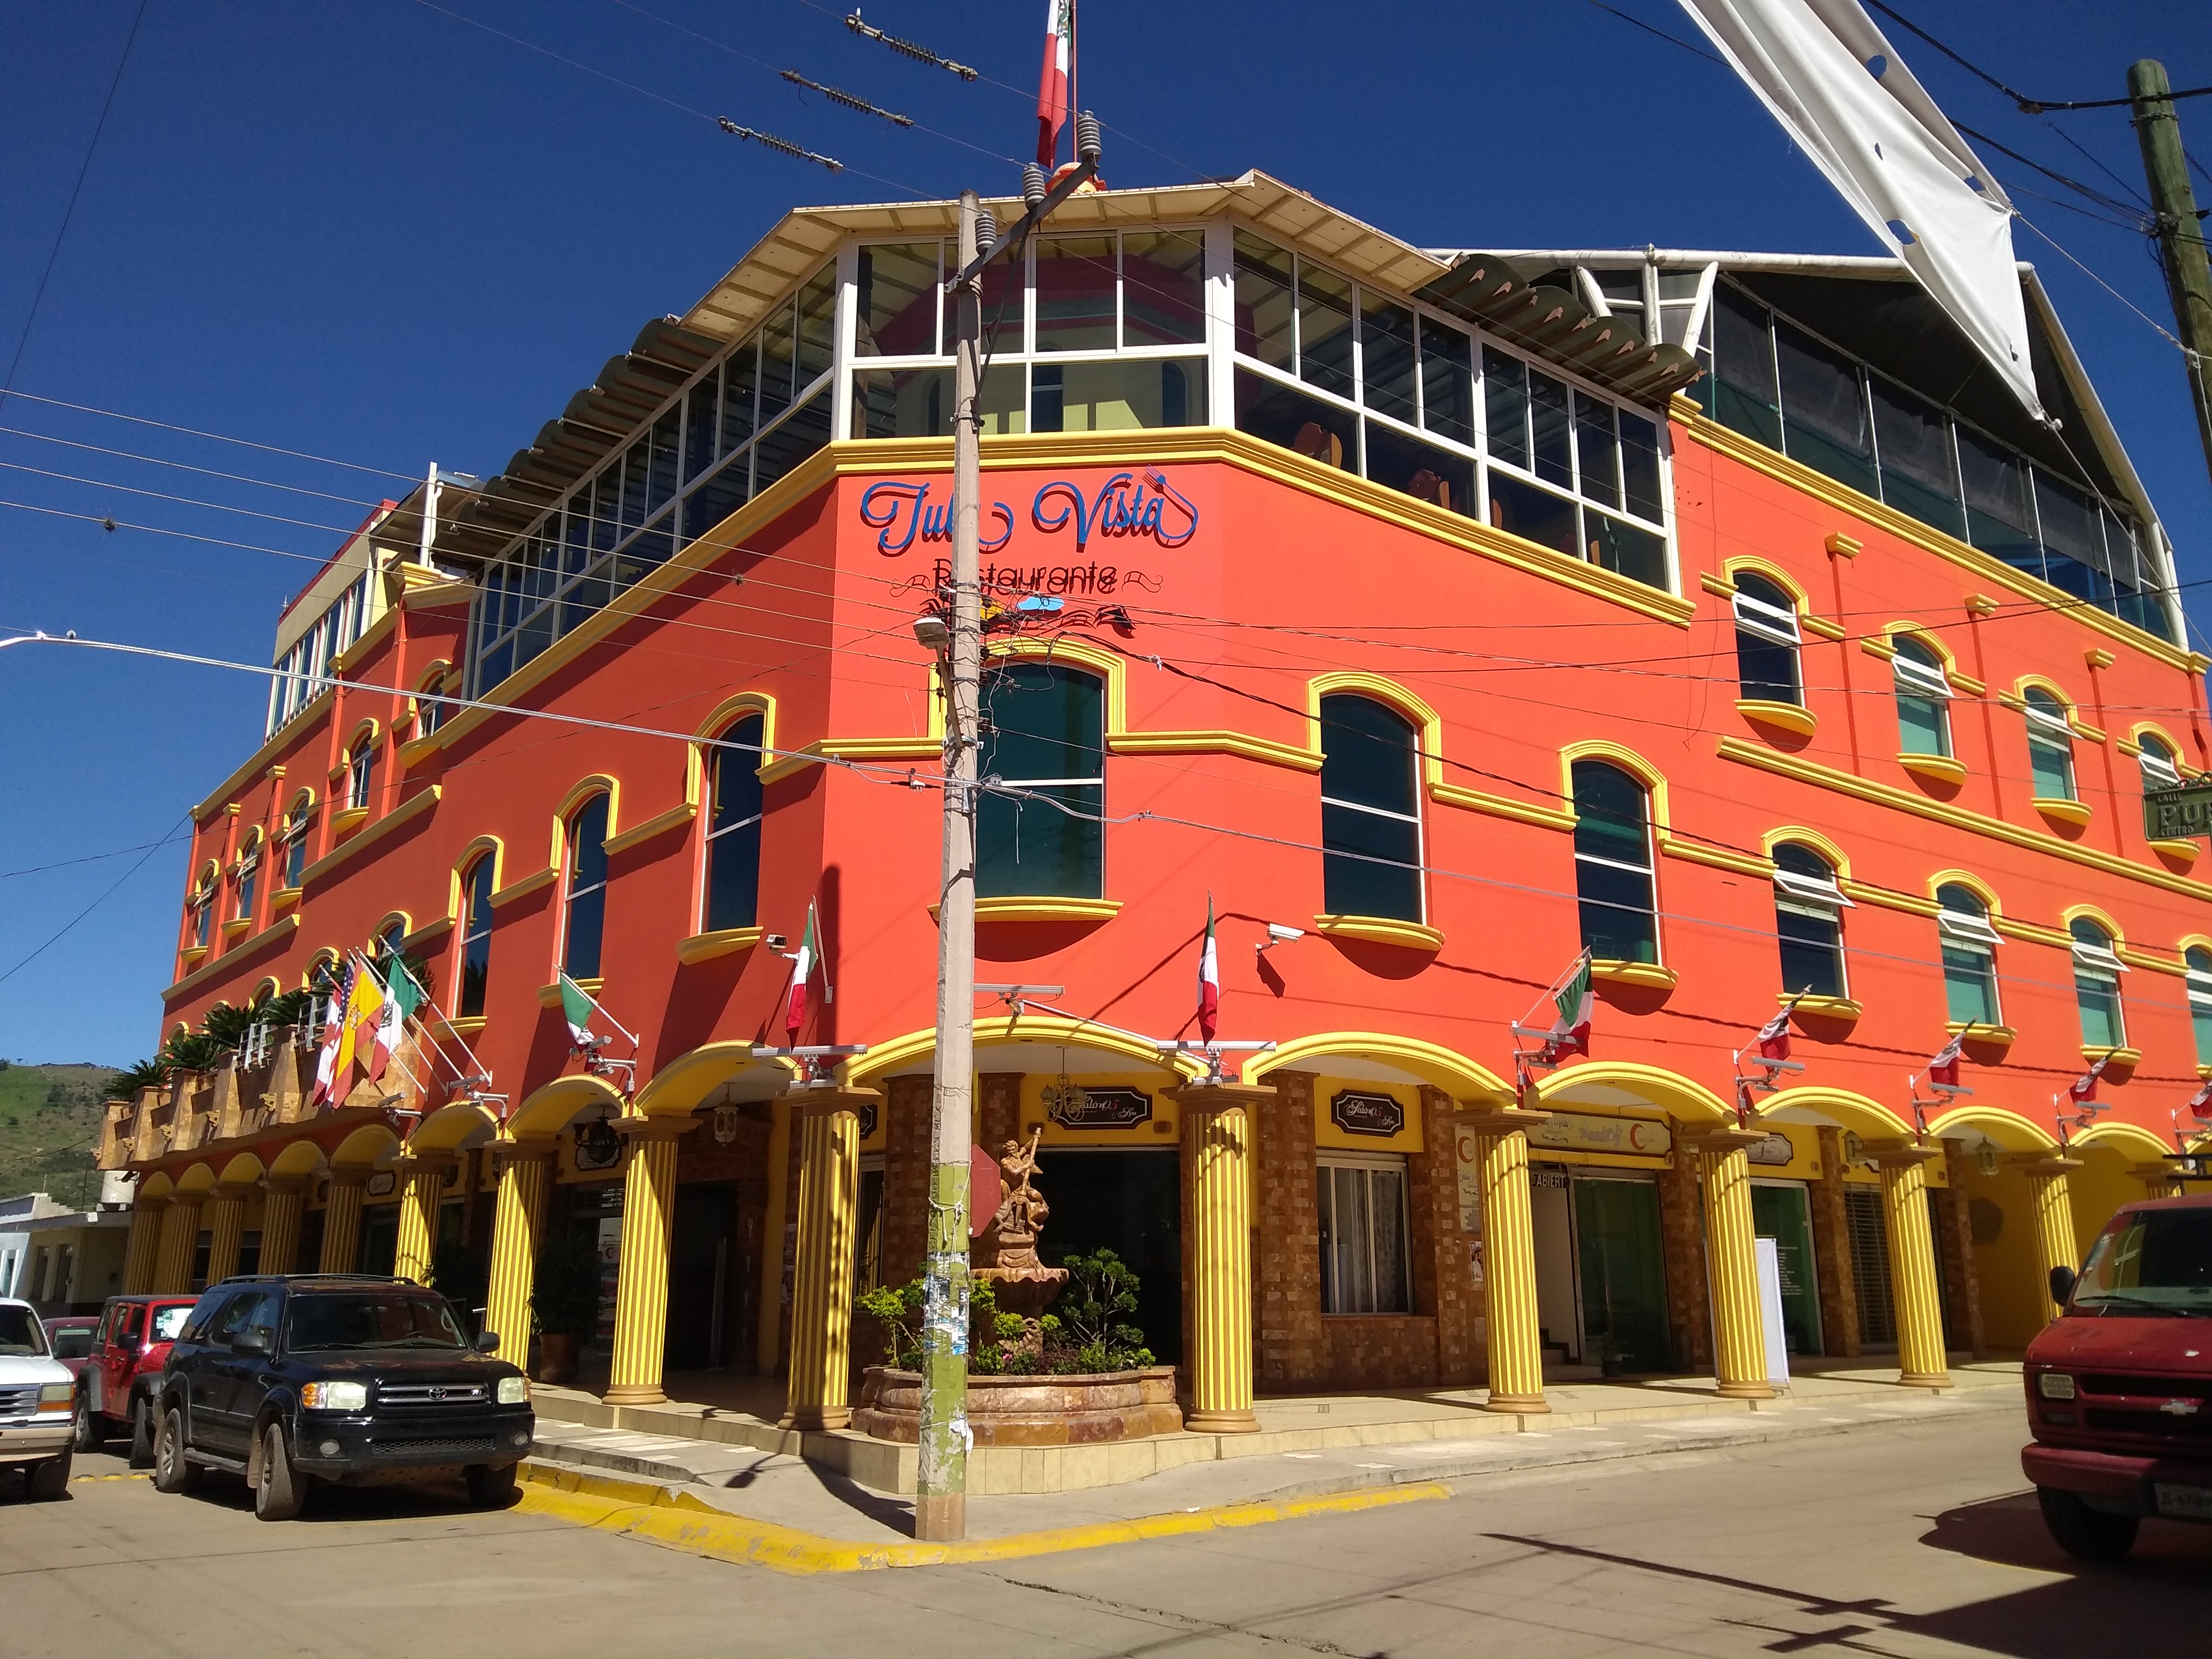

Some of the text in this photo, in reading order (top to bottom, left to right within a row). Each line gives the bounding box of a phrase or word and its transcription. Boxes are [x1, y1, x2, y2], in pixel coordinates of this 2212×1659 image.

[1033, 472, 1199, 543] Vista
[2161, 825, 2194, 836] CENTRO
[1536, 1174, 1566, 1188] ABIERT
